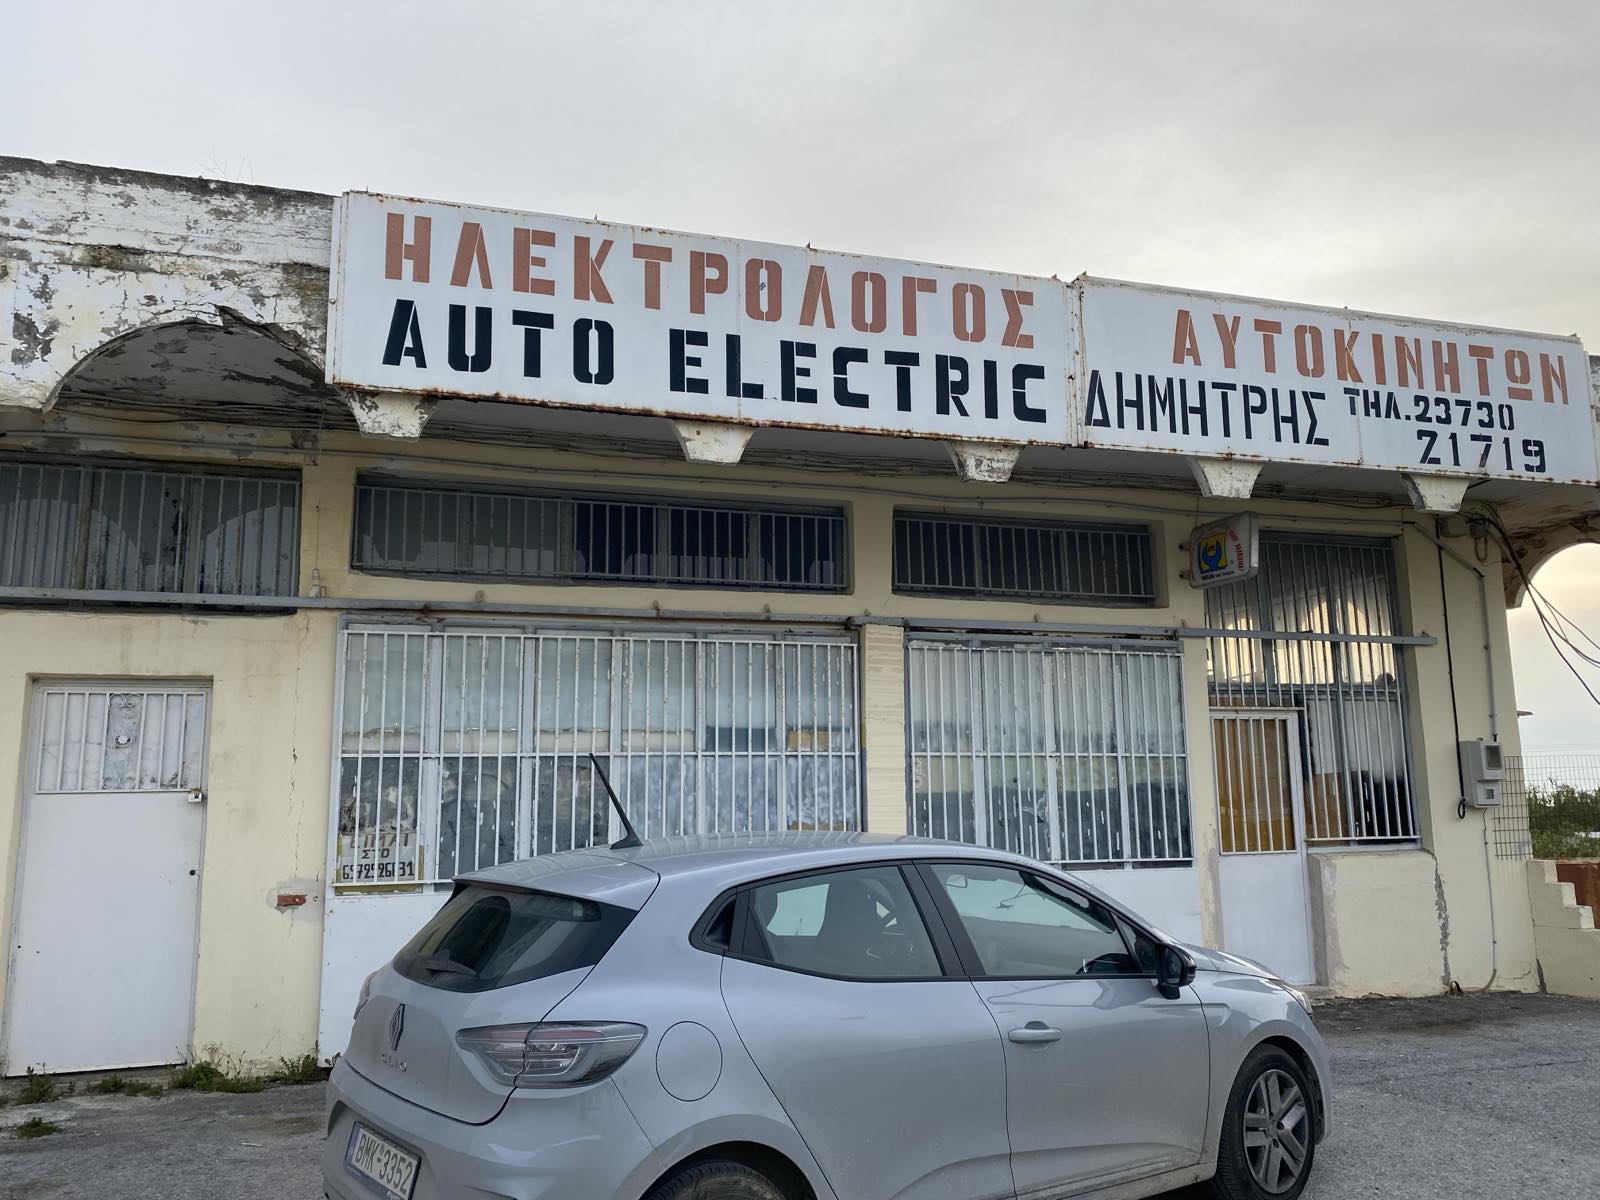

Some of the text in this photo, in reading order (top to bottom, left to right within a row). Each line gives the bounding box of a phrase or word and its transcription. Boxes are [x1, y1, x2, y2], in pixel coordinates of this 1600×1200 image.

[385, 212, 1034, 349] ΗΛΕΚΤΡΟΛΟΓΟΣ
[382, 298, 1047, 423] AUTO ELECTRIC
[1172, 309, 1570, 405] ΑΥΤΟΚΙΝΗΤΩΝ
[1085, 370, 1329, 446] ΔΗΜΗΤΡΗΣ
[1416, 429, 1546, 473] 21719
